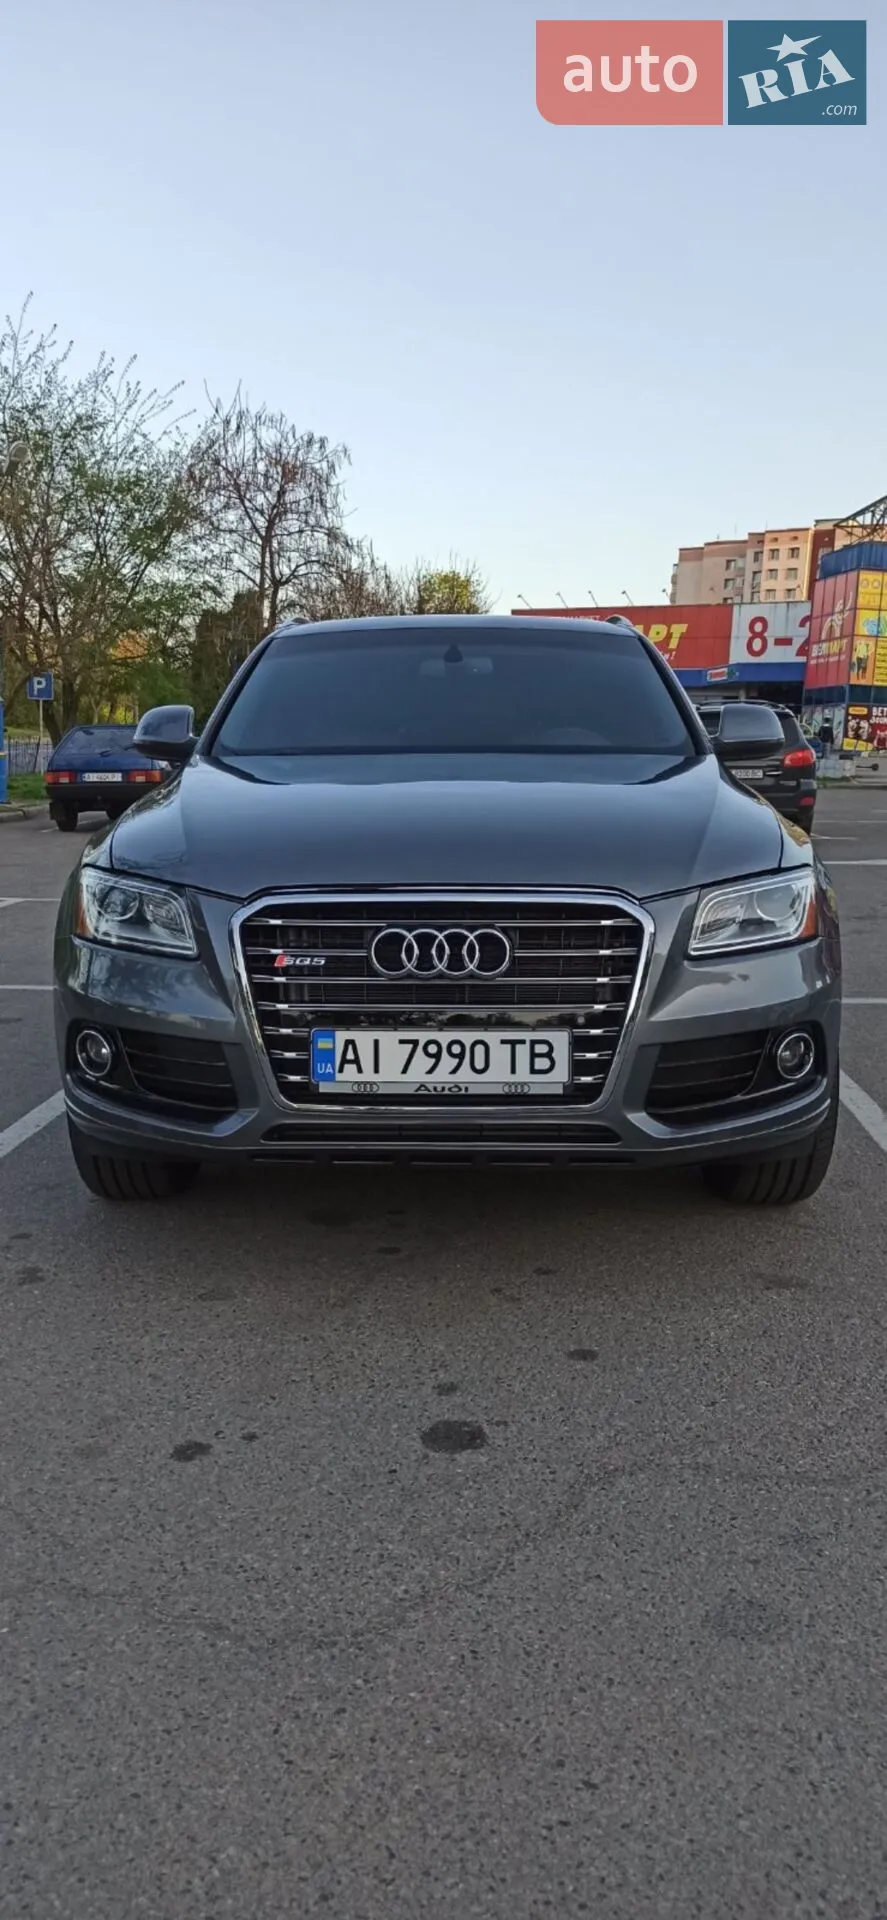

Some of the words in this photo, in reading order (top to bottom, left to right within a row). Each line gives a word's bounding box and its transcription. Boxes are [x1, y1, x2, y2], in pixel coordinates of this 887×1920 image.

[33, 676, 46, 695] P
[282, 956, 326, 966] SQ5
[337, 1038, 380, 1075] AI
[398, 1038, 490, 1075] 7990
[500, 1038, 556, 1075] TB
[317, 1062, 334, 1074] UA
[413, 1083, 470, 1094] Audi
